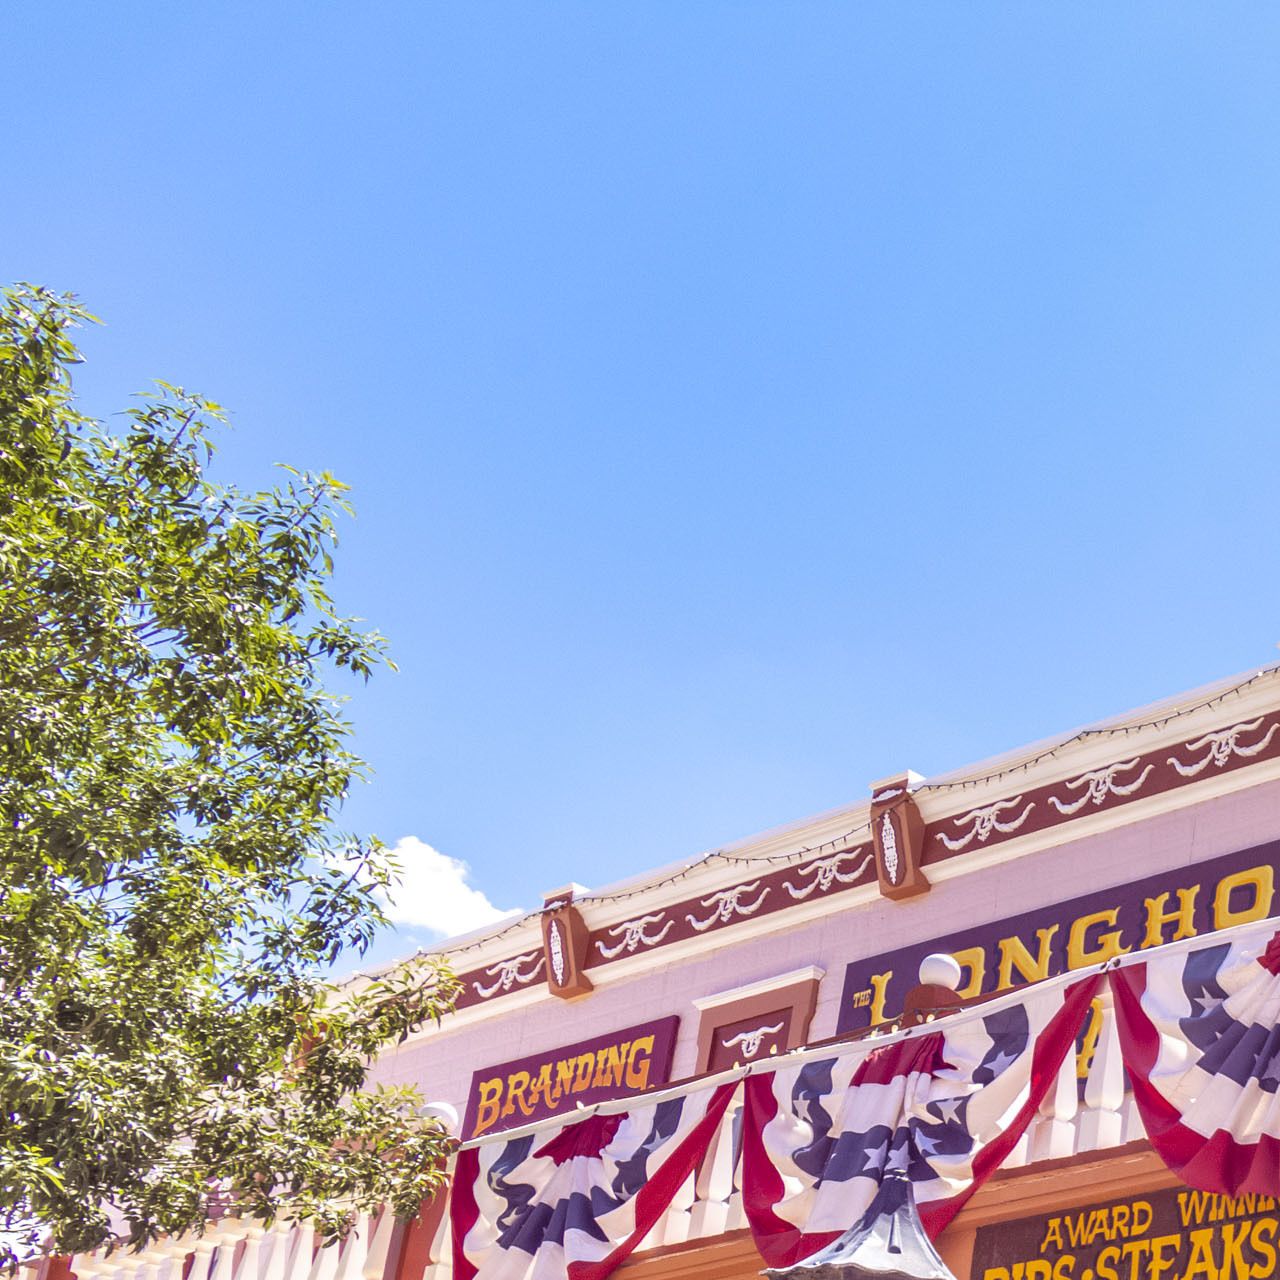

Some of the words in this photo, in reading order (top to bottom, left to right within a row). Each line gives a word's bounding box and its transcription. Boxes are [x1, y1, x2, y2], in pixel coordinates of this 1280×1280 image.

[853, 989, 872, 1009] THE
[472, 1035, 654, 1138] BRANDING
[1040, 1200, 1153, 1253] AWARD
